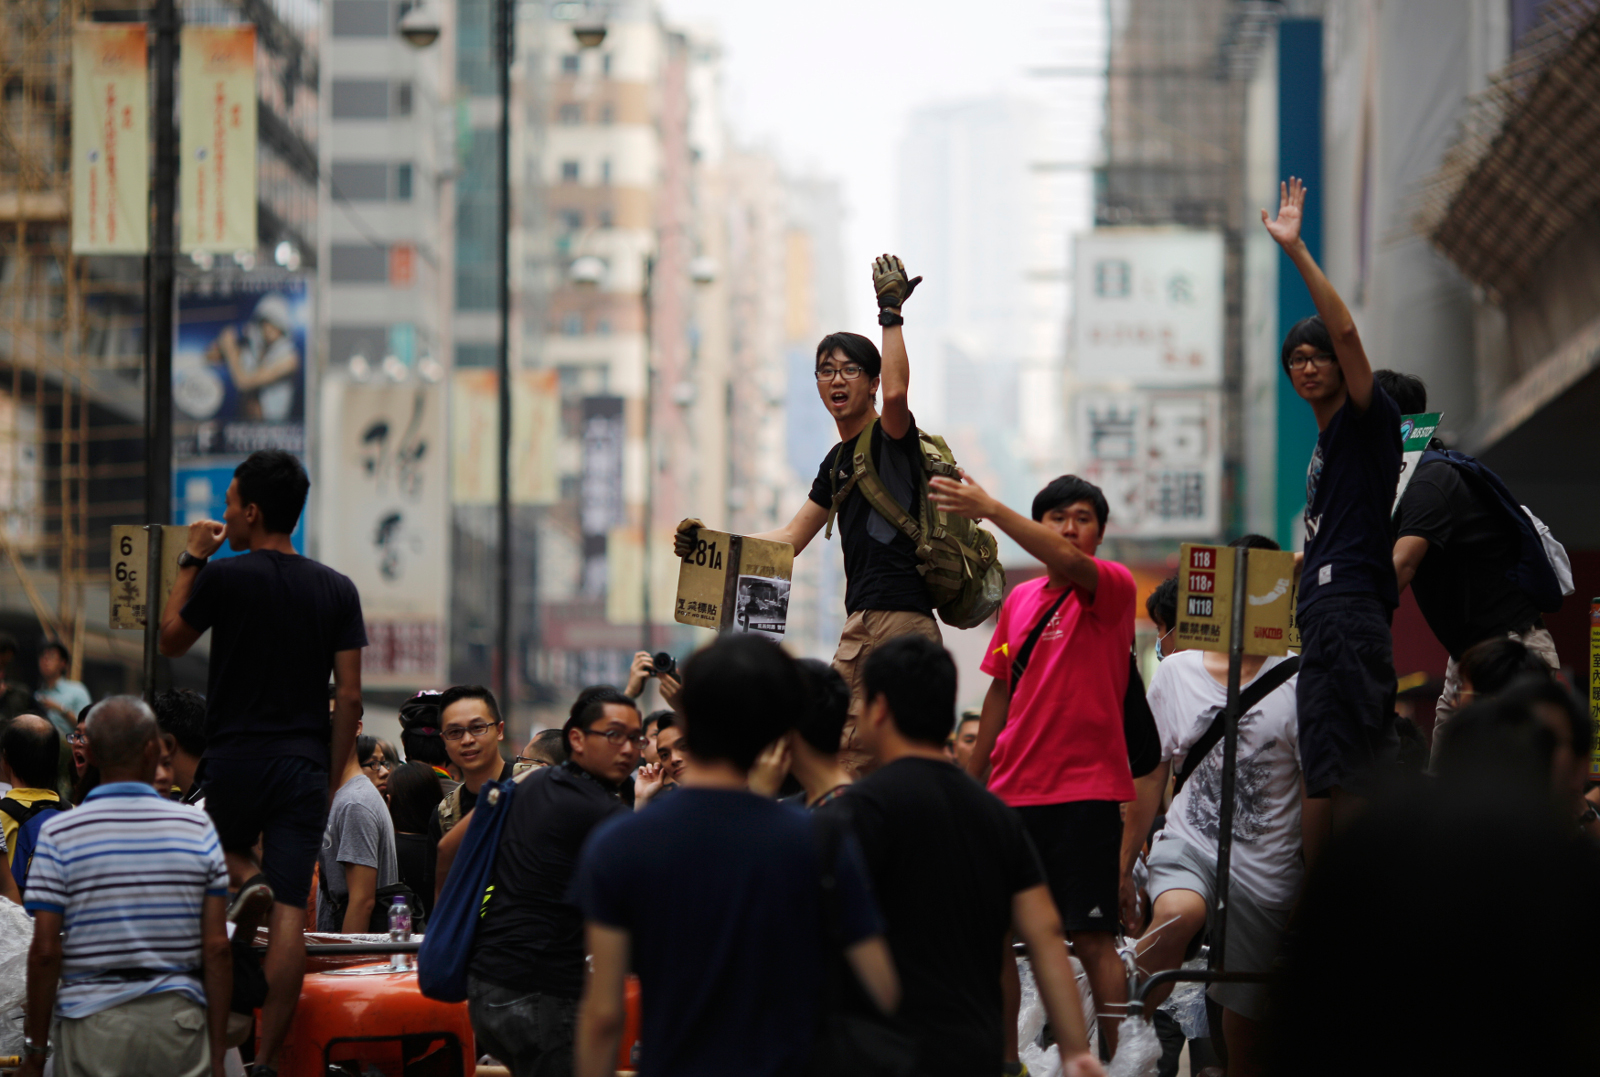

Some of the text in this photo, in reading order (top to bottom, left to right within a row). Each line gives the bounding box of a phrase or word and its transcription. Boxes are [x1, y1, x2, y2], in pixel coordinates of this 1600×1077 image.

[120, 536, 133, 556] 6
[1193, 551, 1211, 568] 118
[1188, 598, 1212, 615] N118
